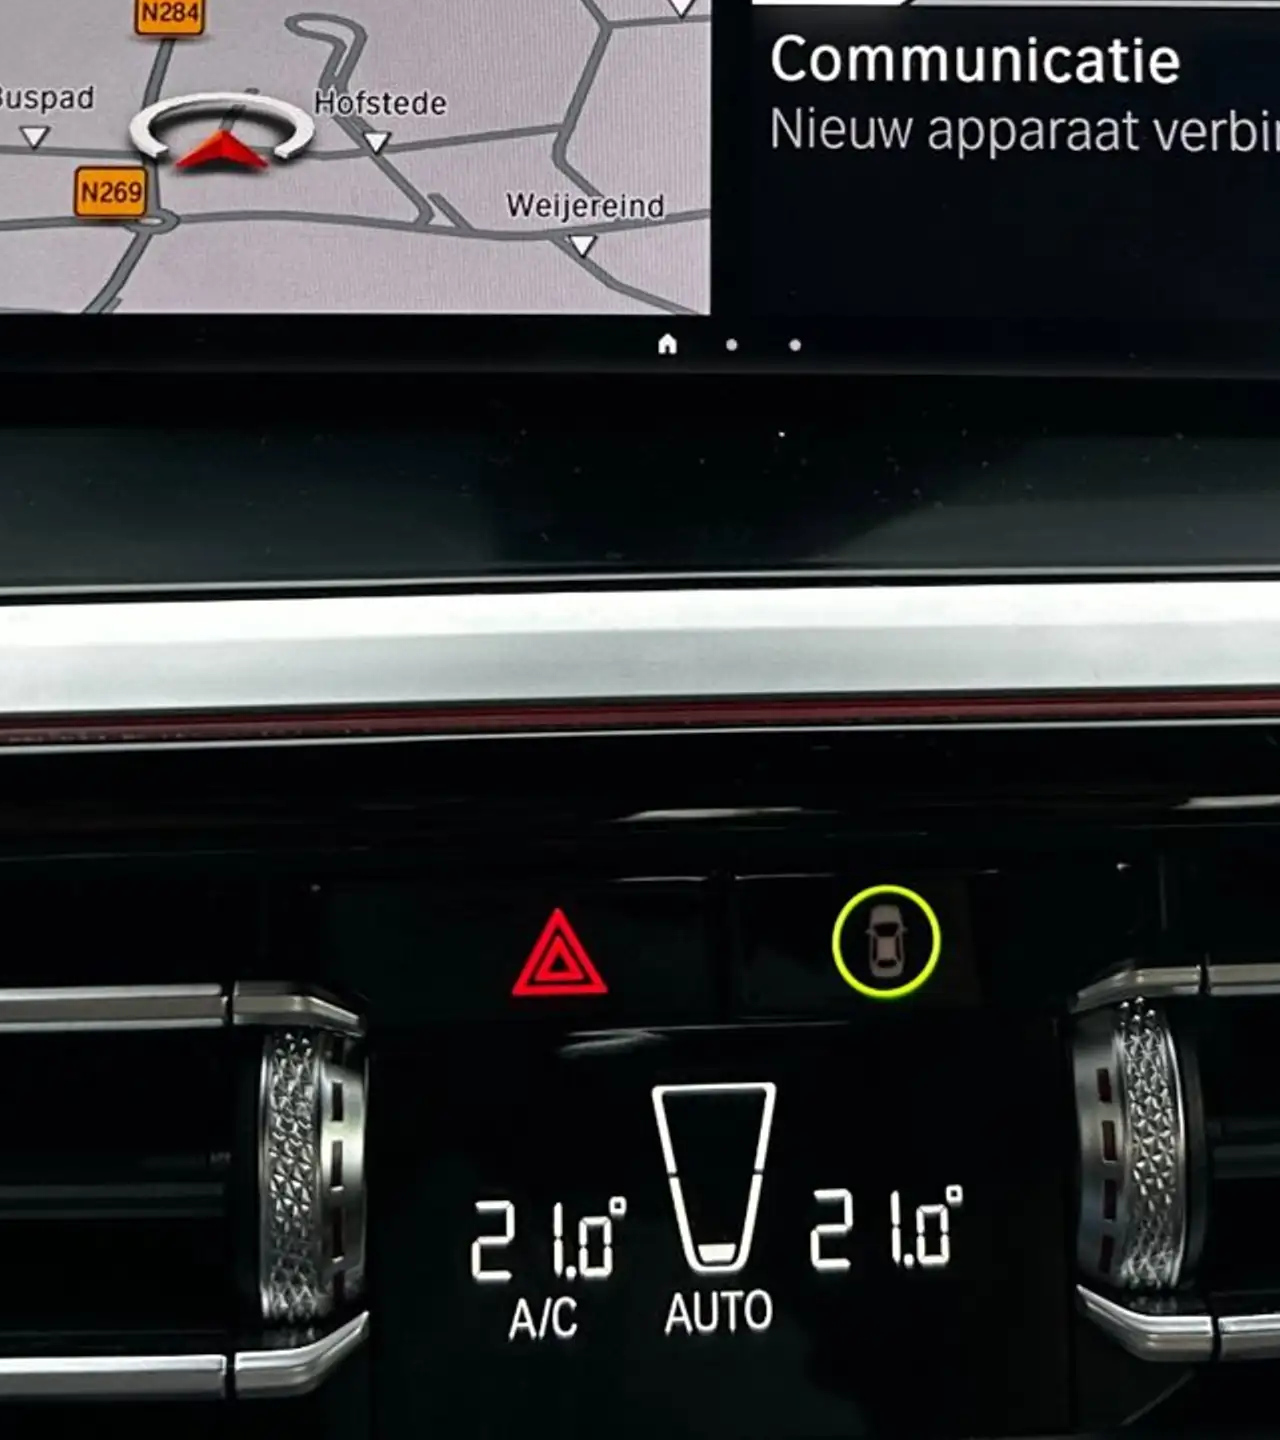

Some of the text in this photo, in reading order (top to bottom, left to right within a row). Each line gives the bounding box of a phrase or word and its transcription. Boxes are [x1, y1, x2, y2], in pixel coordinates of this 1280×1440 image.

[141, 1, 200, 24] N284
[769, 35, 1182, 85] Communicatie
[315, 91, 447, 115] Hofstede
[769, 107, 913, 151] Nieuw
[927, 110, 1140, 159] apparaat
[81, 182, 142, 204] N269
[507, 193, 665, 222] Weijereind
[509, 1297, 578, 1340] A/C
[665, 1289, 773, 1336] AUTO
